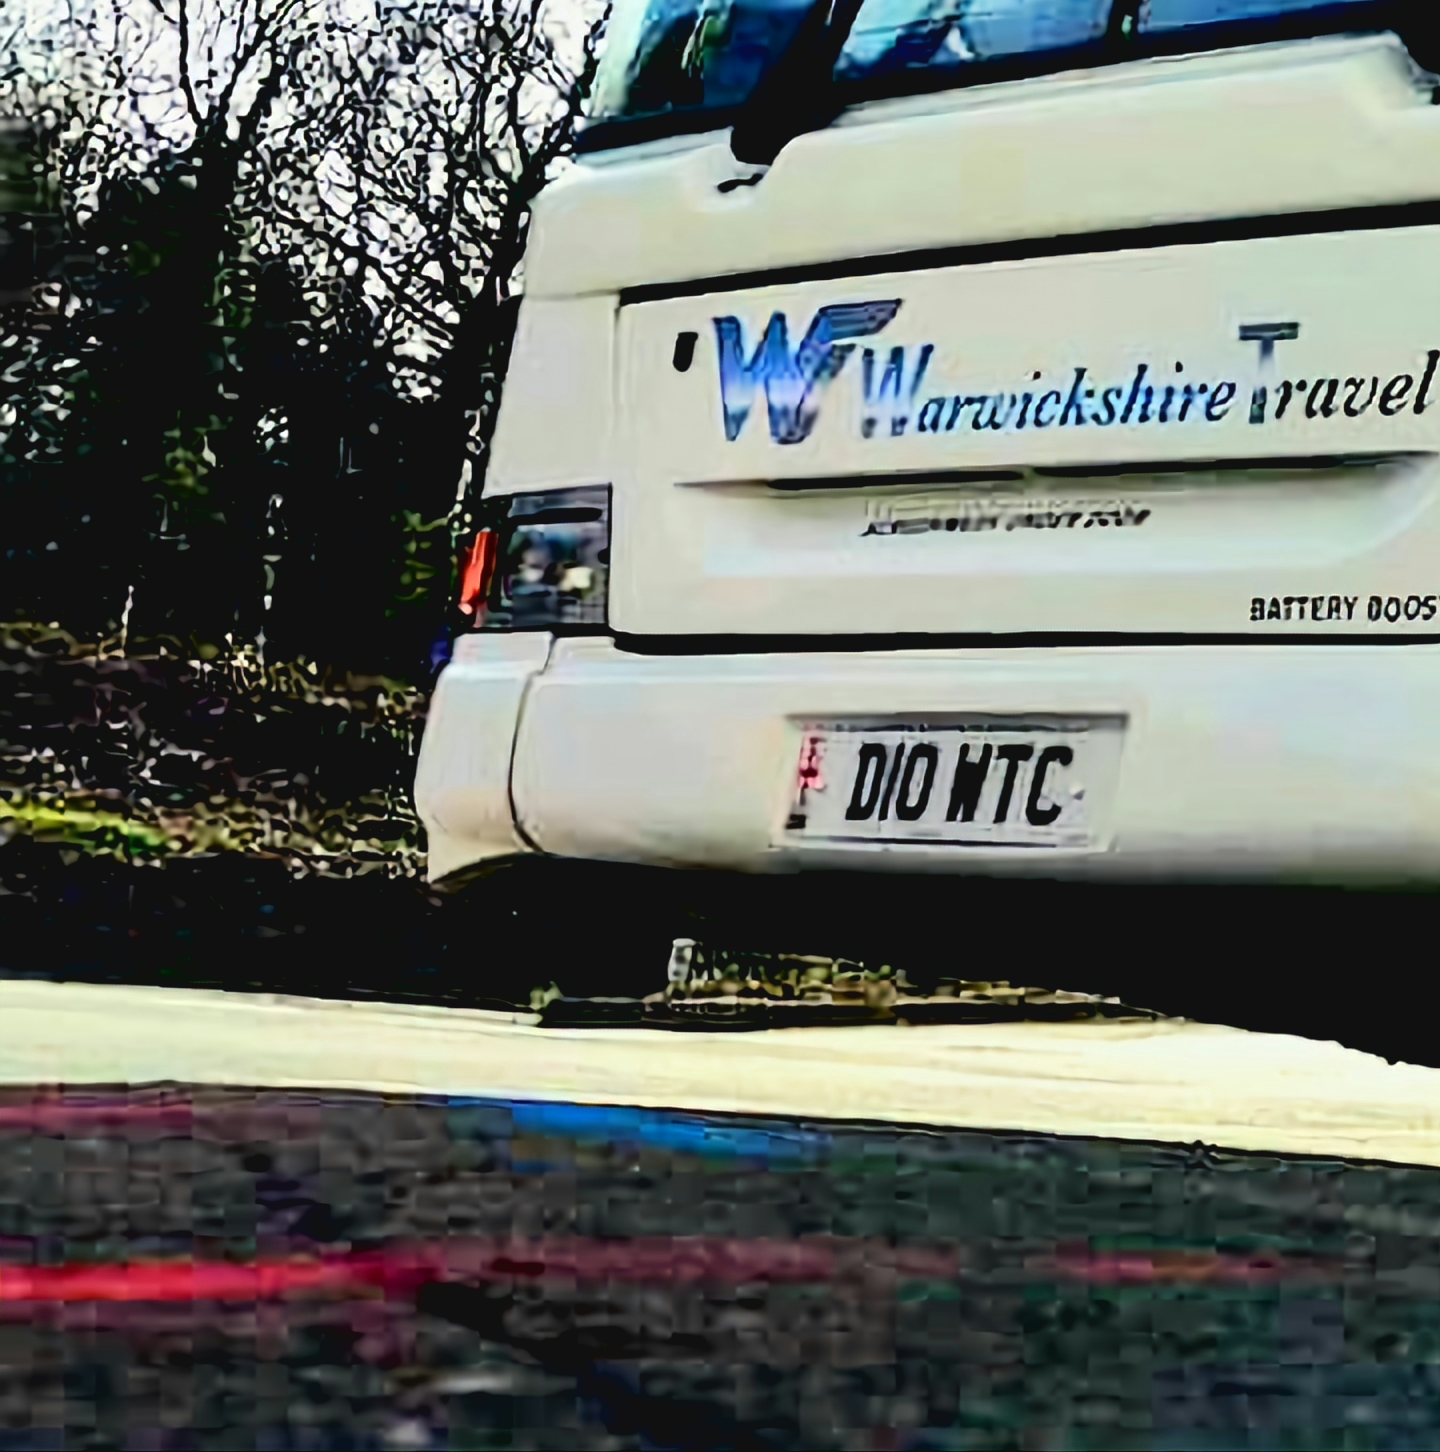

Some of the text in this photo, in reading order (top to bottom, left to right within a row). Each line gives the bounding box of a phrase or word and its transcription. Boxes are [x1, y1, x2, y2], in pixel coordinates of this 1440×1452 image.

[861, 321, 1440, 439] Warwickshire Travel
[1250, 596, 1358, 621] BATTERY
[845, 742, 1074, 826] D10 WTC
